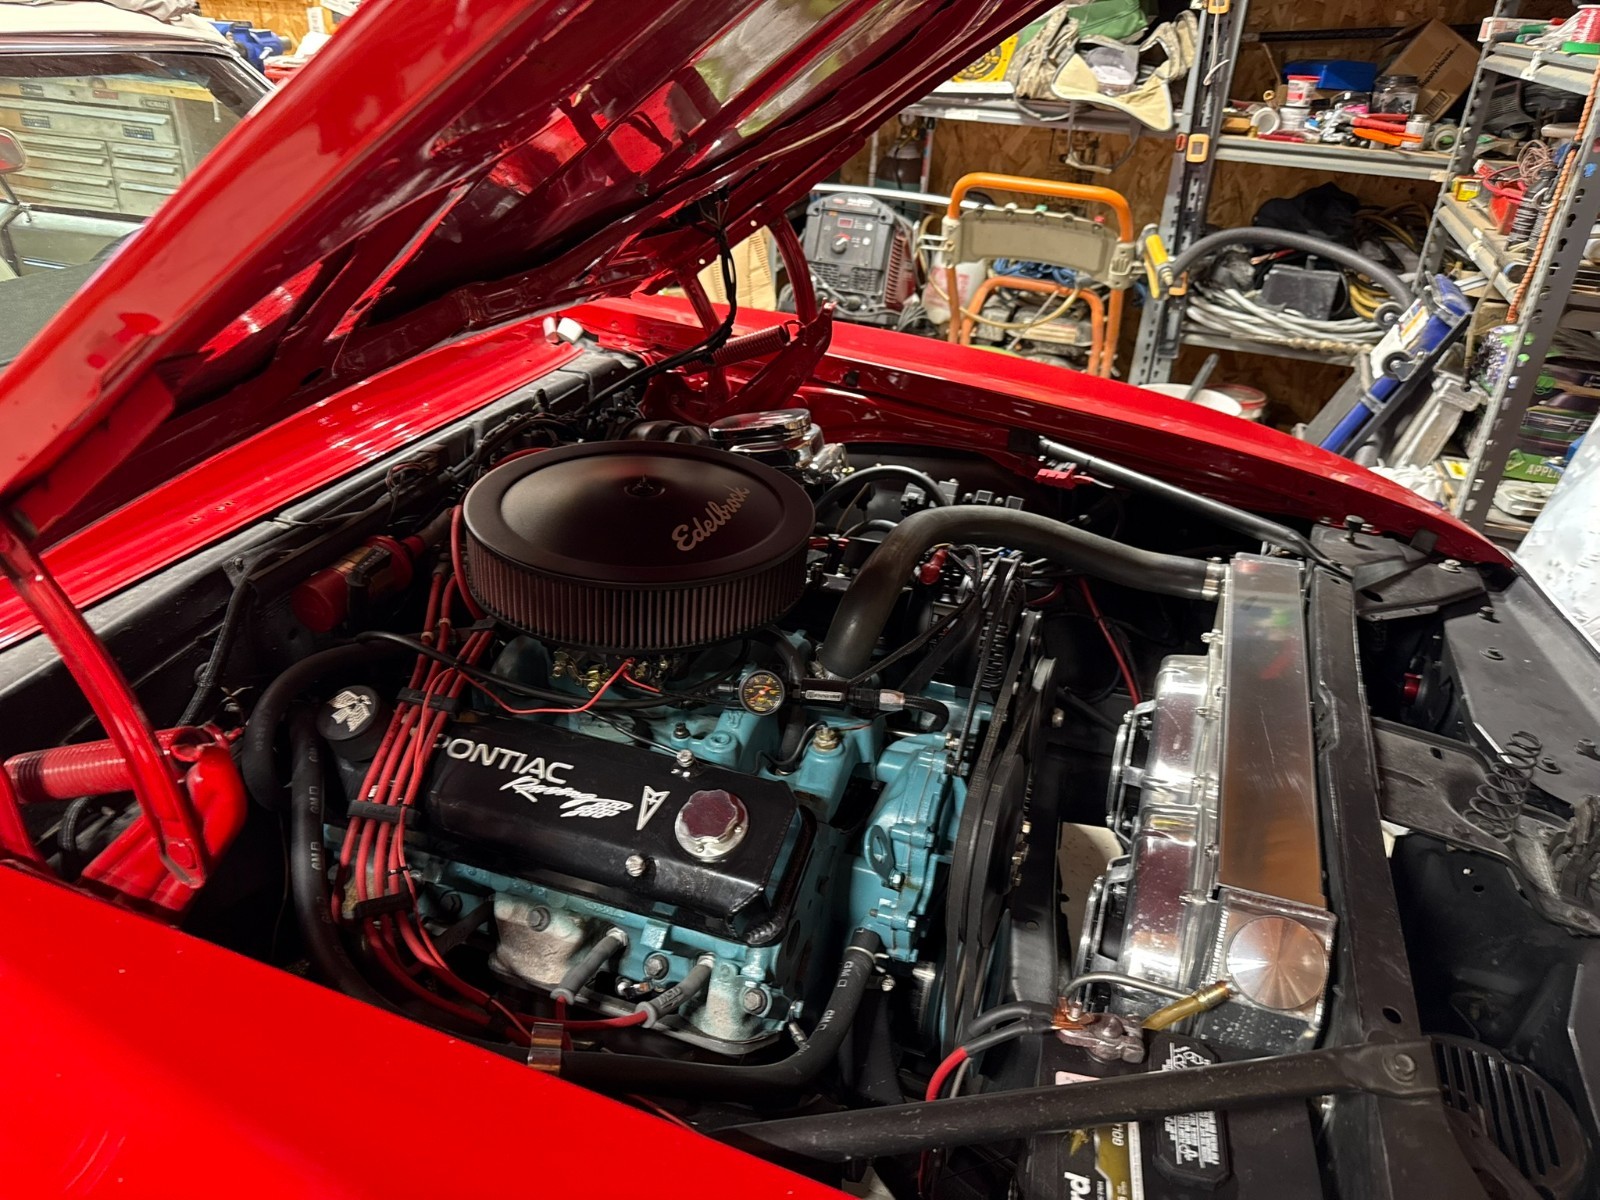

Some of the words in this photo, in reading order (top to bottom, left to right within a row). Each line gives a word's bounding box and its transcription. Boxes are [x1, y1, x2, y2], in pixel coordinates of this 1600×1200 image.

[671, 485, 750, 551] Edelbrock
[499, 776, 600, 810] Racing
[1064, 1171, 1091, 1200] rd
